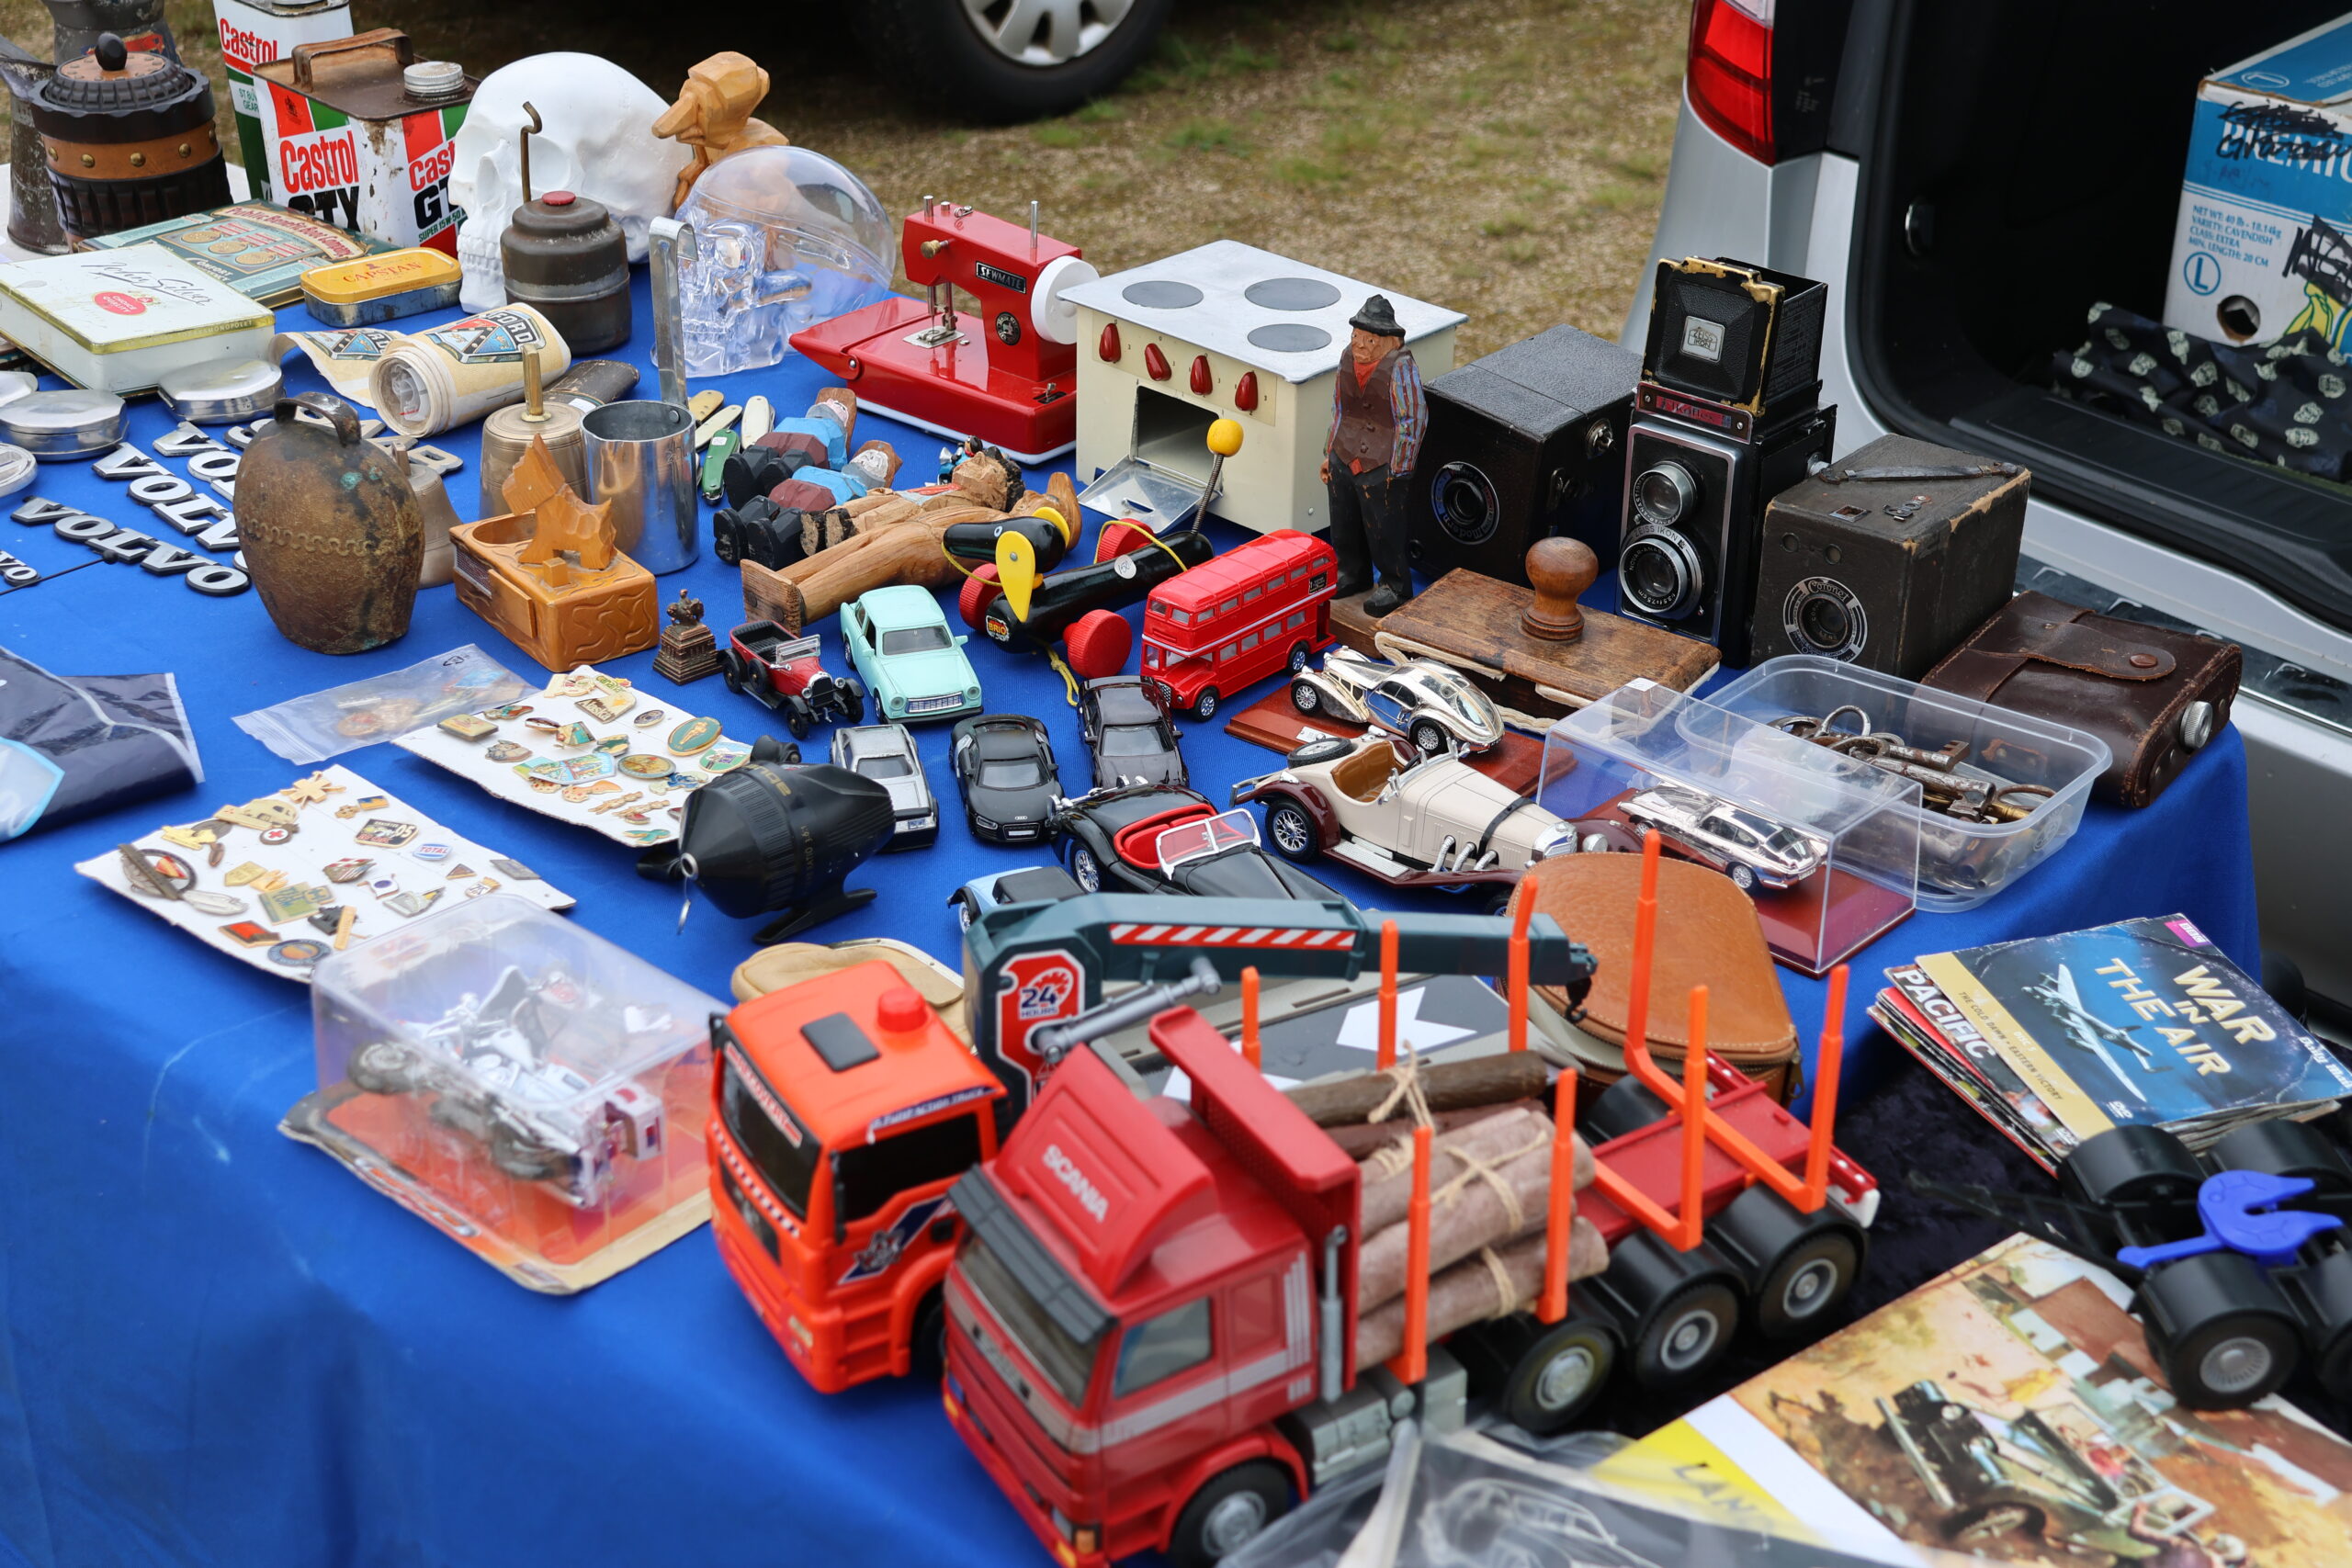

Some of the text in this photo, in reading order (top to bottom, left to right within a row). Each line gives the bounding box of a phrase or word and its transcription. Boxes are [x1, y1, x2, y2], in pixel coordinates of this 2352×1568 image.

[220, 18, 277, 62] Castrol
[279, 130, 359, 194] Castrol
[418, 224, 439, 243] SUPER
[2223, 226, 2274, 246] CAVENDISH
[343, 261, 422, 283] CAPSTAN
[980, 265, 1023, 289] SEWMATE
[2194, 256, 2209, 291] L
[102, 295, 132, 314] QUALITY
[111, 294, 137, 310] CHOICE
[1692, 328, 1713, 342] ZEISS
[1693, 338, 1712, 349] IKON
[92, 442, 249, 573] VOLV
[1634, 524, 1679, 542] ZEISS IKON
[10, 496, 252, 597] VOLVO
[1807, 580, 1850, 603] Coronet
[988, 622, 1007, 635] BRIO
[419, 845, 447, 854] TOTAL
[2178, 921, 2207, 943] BBC
[1021, 985, 1057, 1009] 24
[2095, 957, 2177, 1021] THE
[1020, 1006, 1057, 1018] HOURS
[1893, 969, 1997, 1059] PACIFIC
[2172, 1000, 2210, 1024] IN
[2173, 964, 2278, 1044] WAR
[1958, 991, 2064, 1101] THE COLD DAWN EASTERN VICTORY
[2154, 1027, 2232, 1076] AIR
[2298, 1035, 2329, 1065] Daily
[1042, 1145, 1109, 1224] SCANIA
